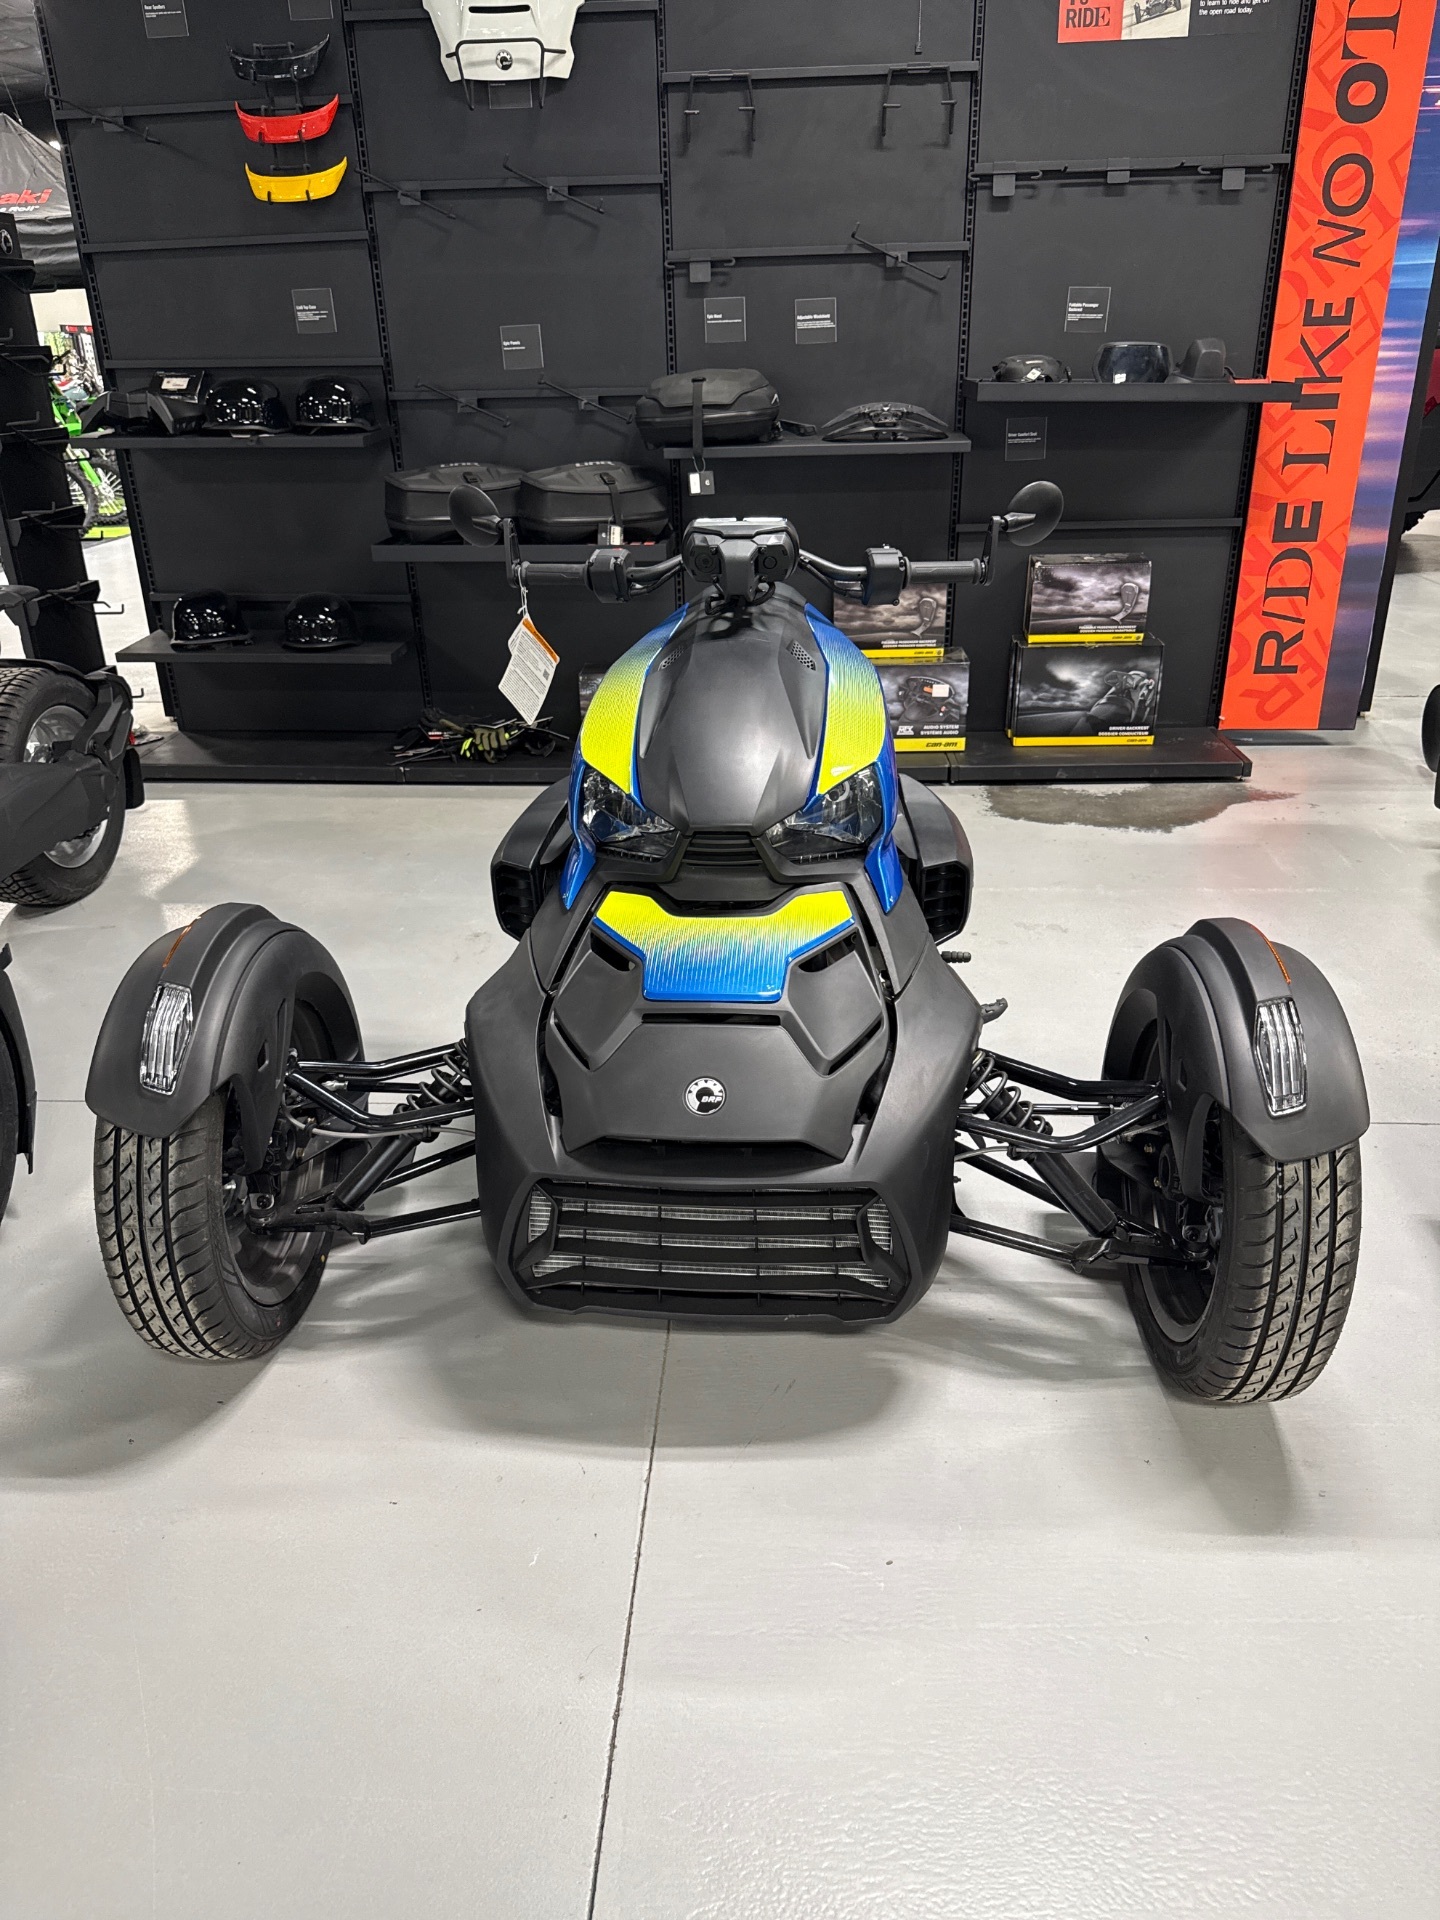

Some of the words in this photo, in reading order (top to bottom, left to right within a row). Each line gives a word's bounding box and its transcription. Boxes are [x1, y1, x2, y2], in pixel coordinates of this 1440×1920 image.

[1065, 6, 1111, 29] RIDE
[1209, 9, 1223, 17] open
[1224, 7, 1237, 15] road
[1238, 7, 1253, 15] today.
[1312, 153, 1374, 268] NO
[1281, 297, 1356, 476] LIKE
[1253, 500, 1324, 675] RIDE
